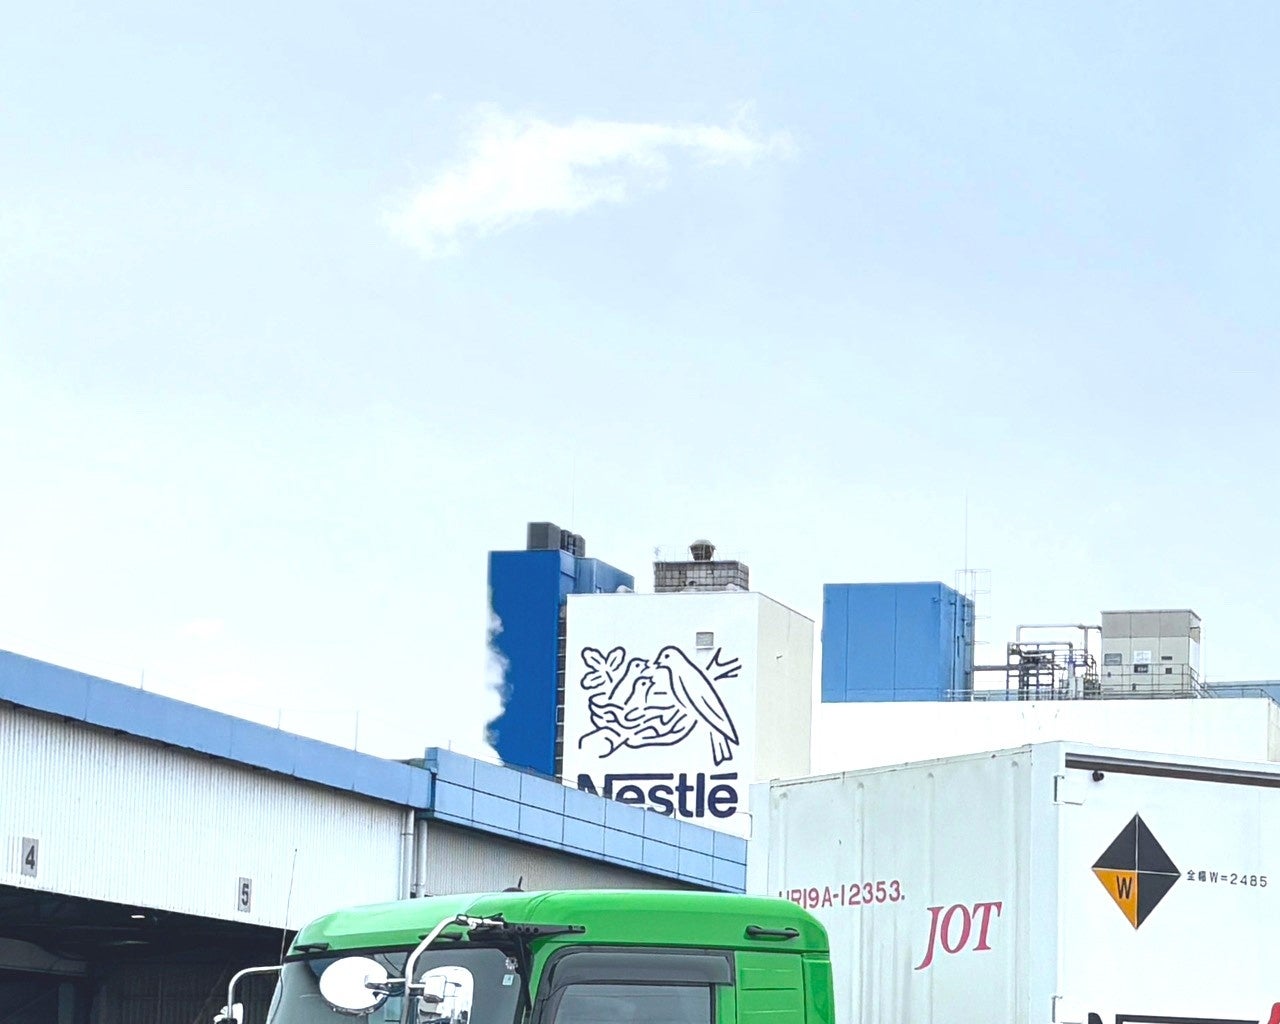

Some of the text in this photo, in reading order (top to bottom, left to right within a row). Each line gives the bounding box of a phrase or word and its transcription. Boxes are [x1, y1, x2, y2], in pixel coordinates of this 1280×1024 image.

[25, 845, 36, 870] 4
[241, 883, 250, 906] 5
[1116, 875, 1133, 900] W
[914, 901, 1003, 970] JOT
